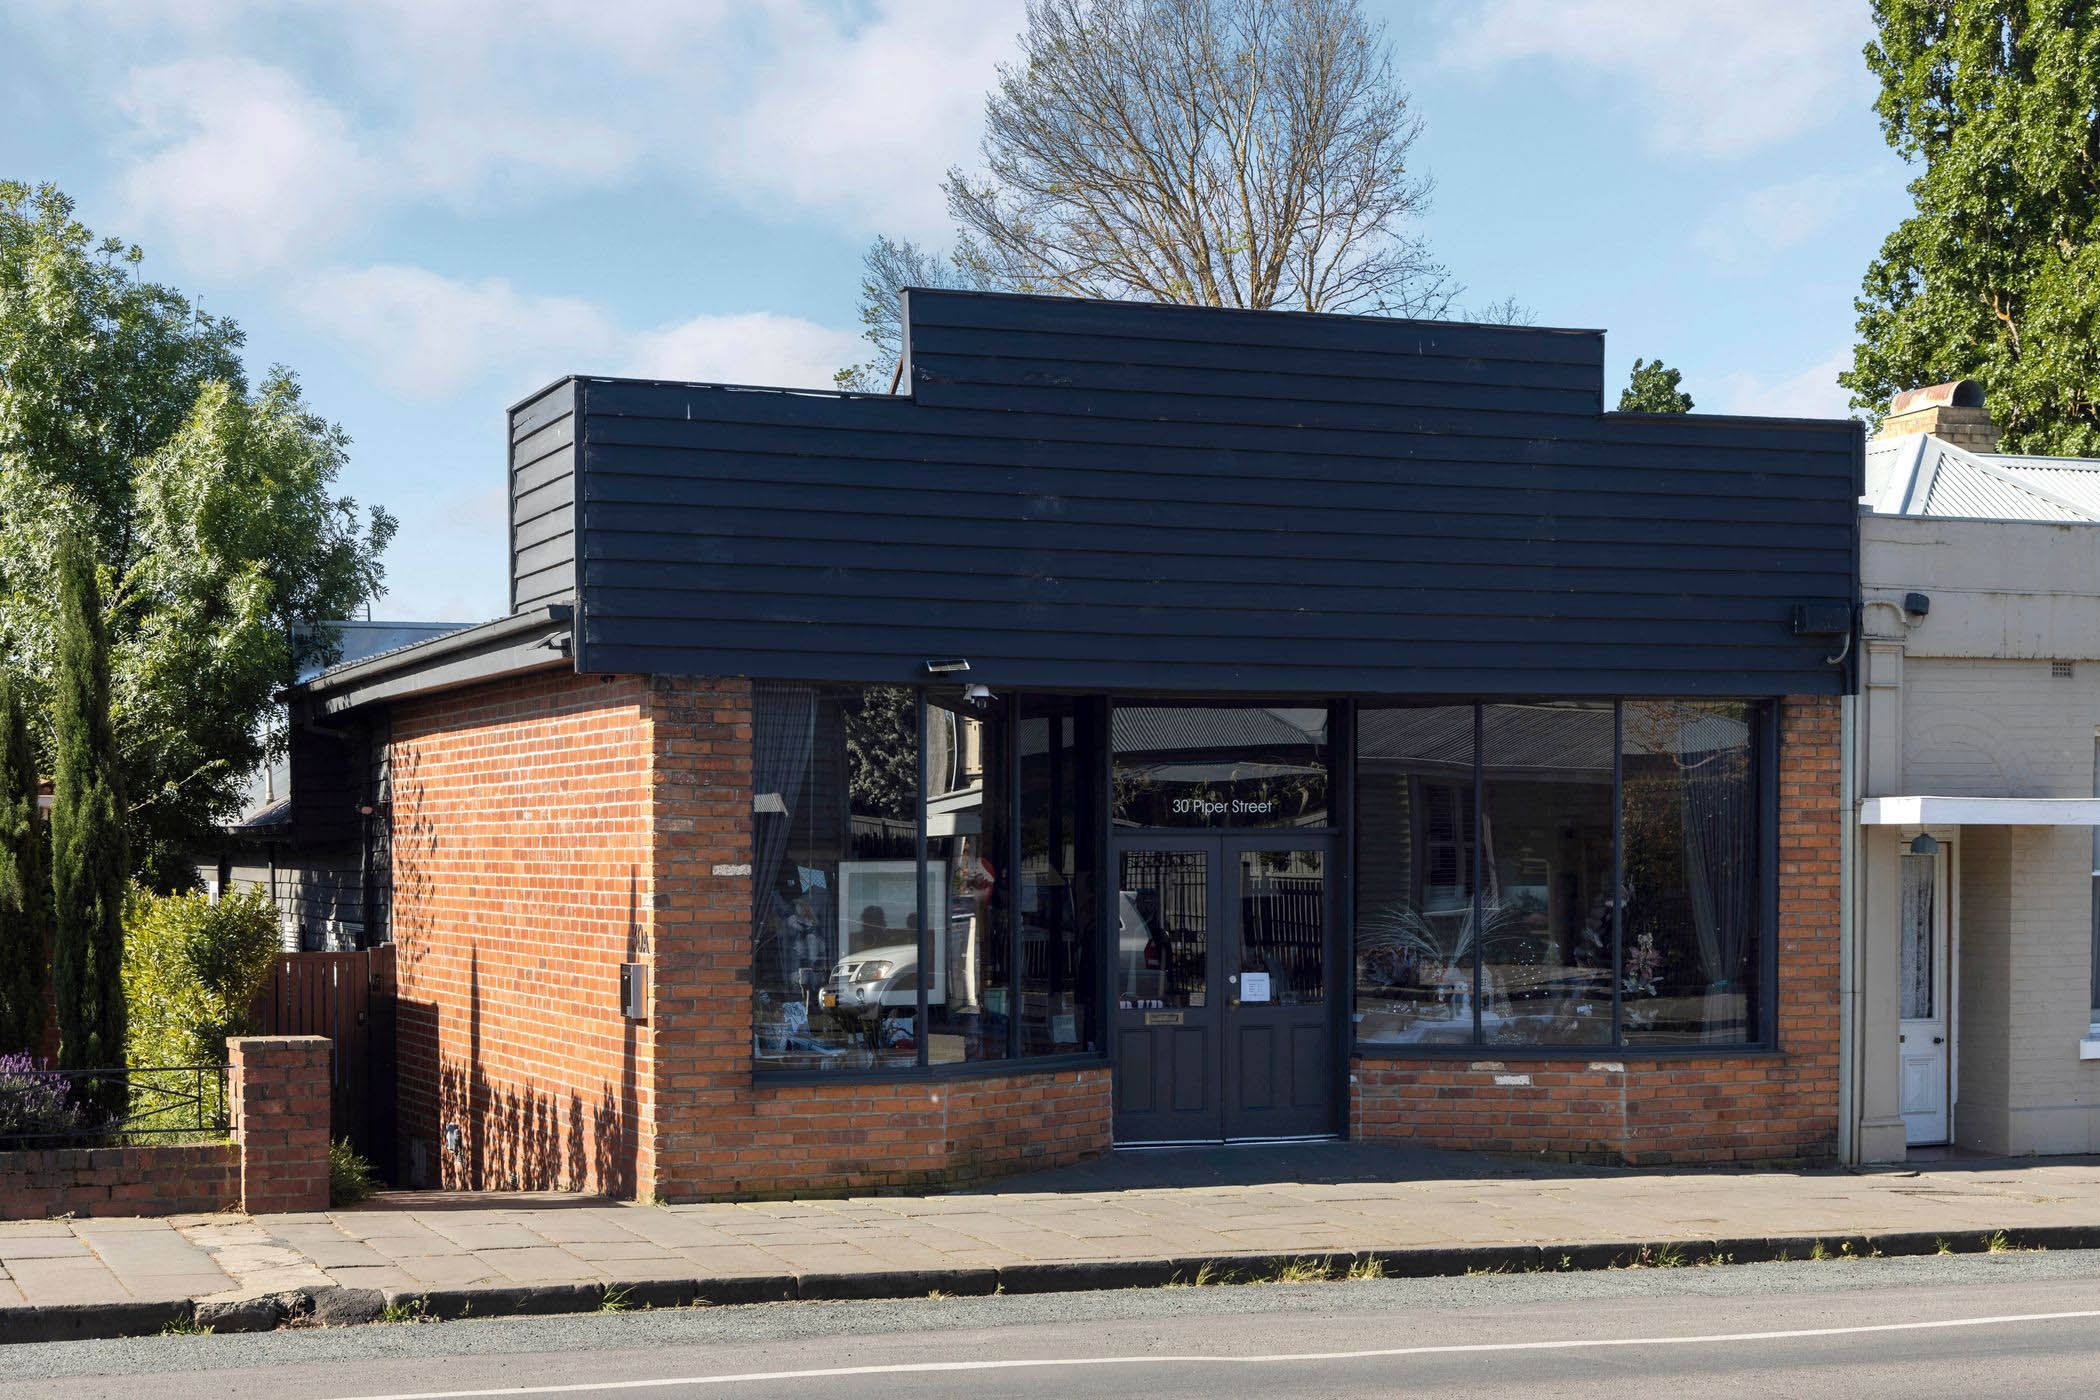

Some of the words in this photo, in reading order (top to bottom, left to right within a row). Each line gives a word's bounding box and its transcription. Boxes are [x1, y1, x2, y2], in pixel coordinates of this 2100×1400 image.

[1172, 798, 1189, 813] 30
[1193, 798, 1228, 816] Piper
[1232, 798, 1273, 813] Street
